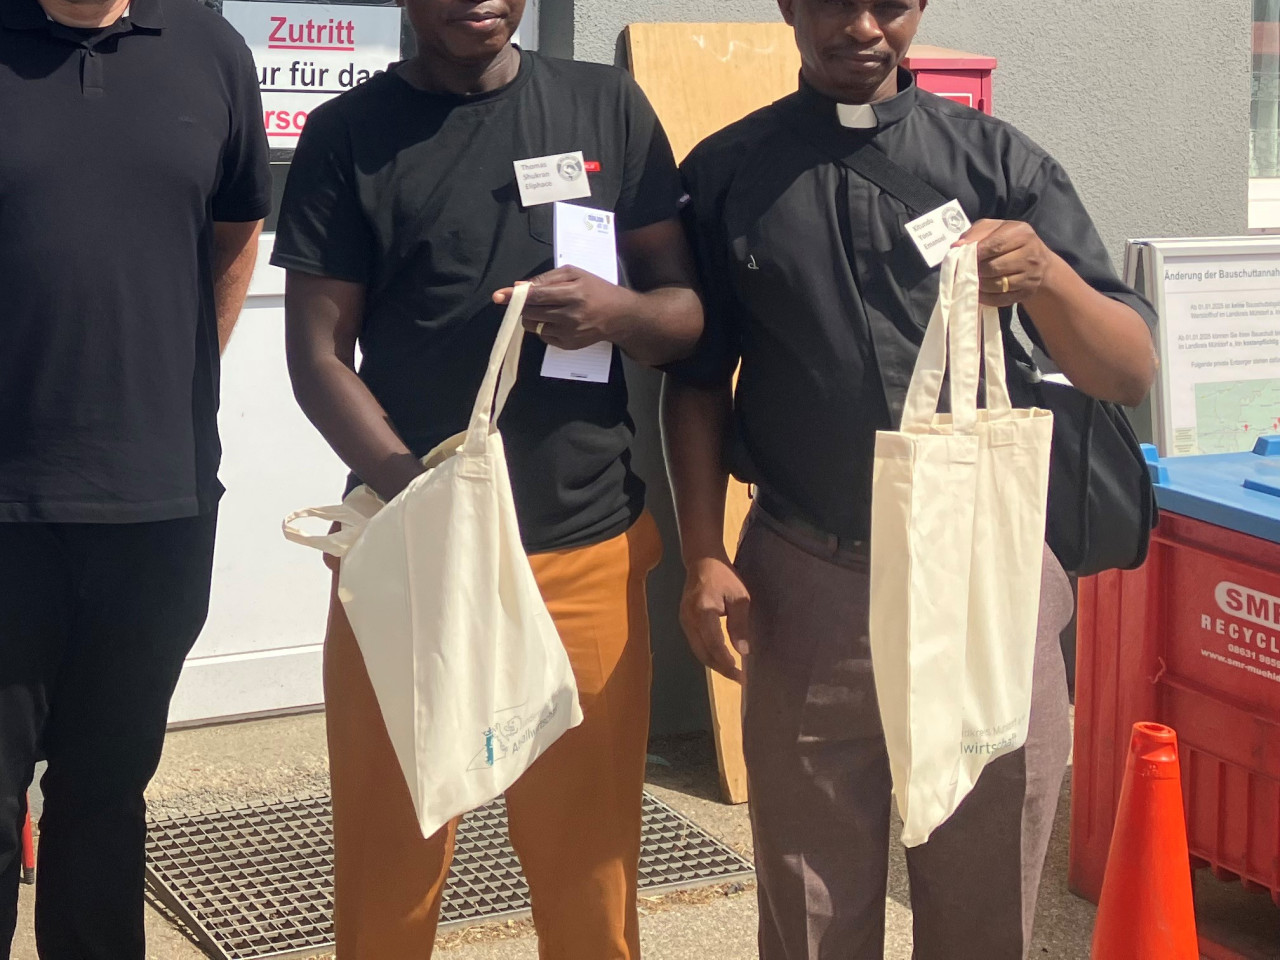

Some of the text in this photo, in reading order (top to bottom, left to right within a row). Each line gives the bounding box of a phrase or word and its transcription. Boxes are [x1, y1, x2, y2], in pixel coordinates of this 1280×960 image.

[269, 16, 355, 45] Zutritt
[259, 67, 281, 86] ur
[289, 61, 329, 87] für
[1164, 270, 1202, 282] Änderung
[1204, 270, 1217, 279] der
[1201, 614, 1279, 654] RECYCL
